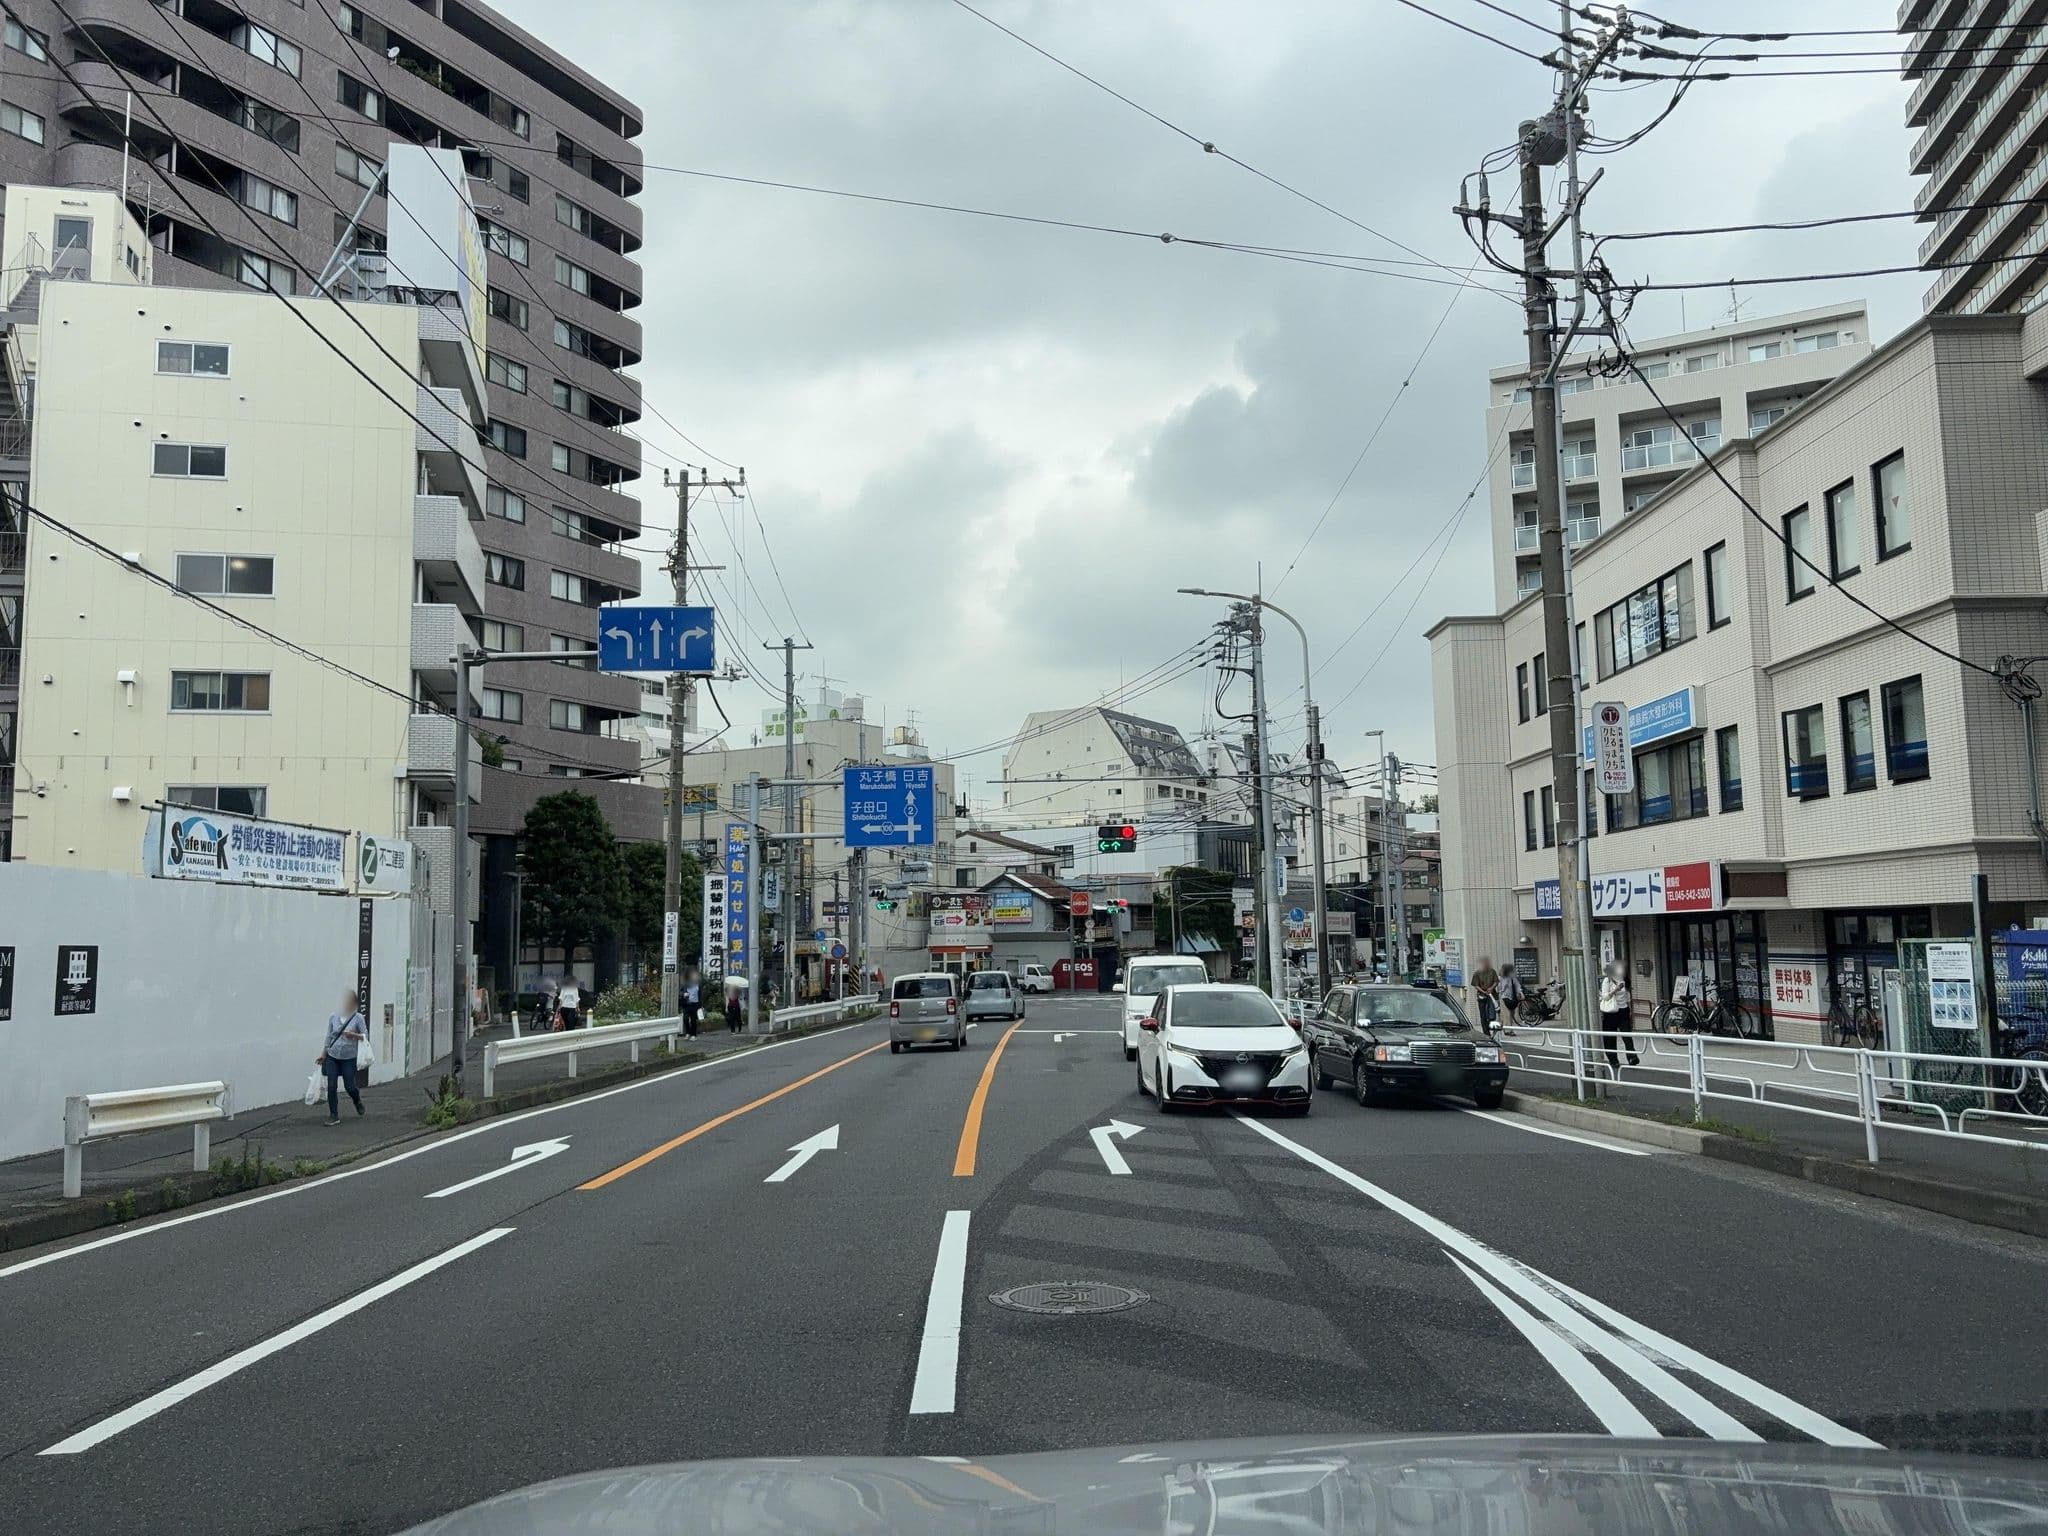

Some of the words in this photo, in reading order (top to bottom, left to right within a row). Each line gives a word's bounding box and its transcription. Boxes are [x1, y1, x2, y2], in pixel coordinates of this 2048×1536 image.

[1609, 727, 1620, 769] たるまち
[859, 770, 897, 782] 丸子橋
[903, 769, 928, 782] 日吉
[905, 782, 926, 790] Hiyoshi
[850, 801, 887, 813] 子母口
[907, 806, 914, 815] 2
[851, 813, 887, 821] Shibokuchi
[730, 826, 745, 843] 薬
[231, 824, 341, 861] 労働災害防止活動の推進
[185, 856, 215, 867] KANAGAWA
[379, 847, 405, 869] 不二建設
[1592, 872, 1662, 910] サクシード
[708, 879, 724, 981] 振替納税推進の街
[2021, 948, 2047, 962] Asahi
[1775, 968, 1812, 986] 無料体験
